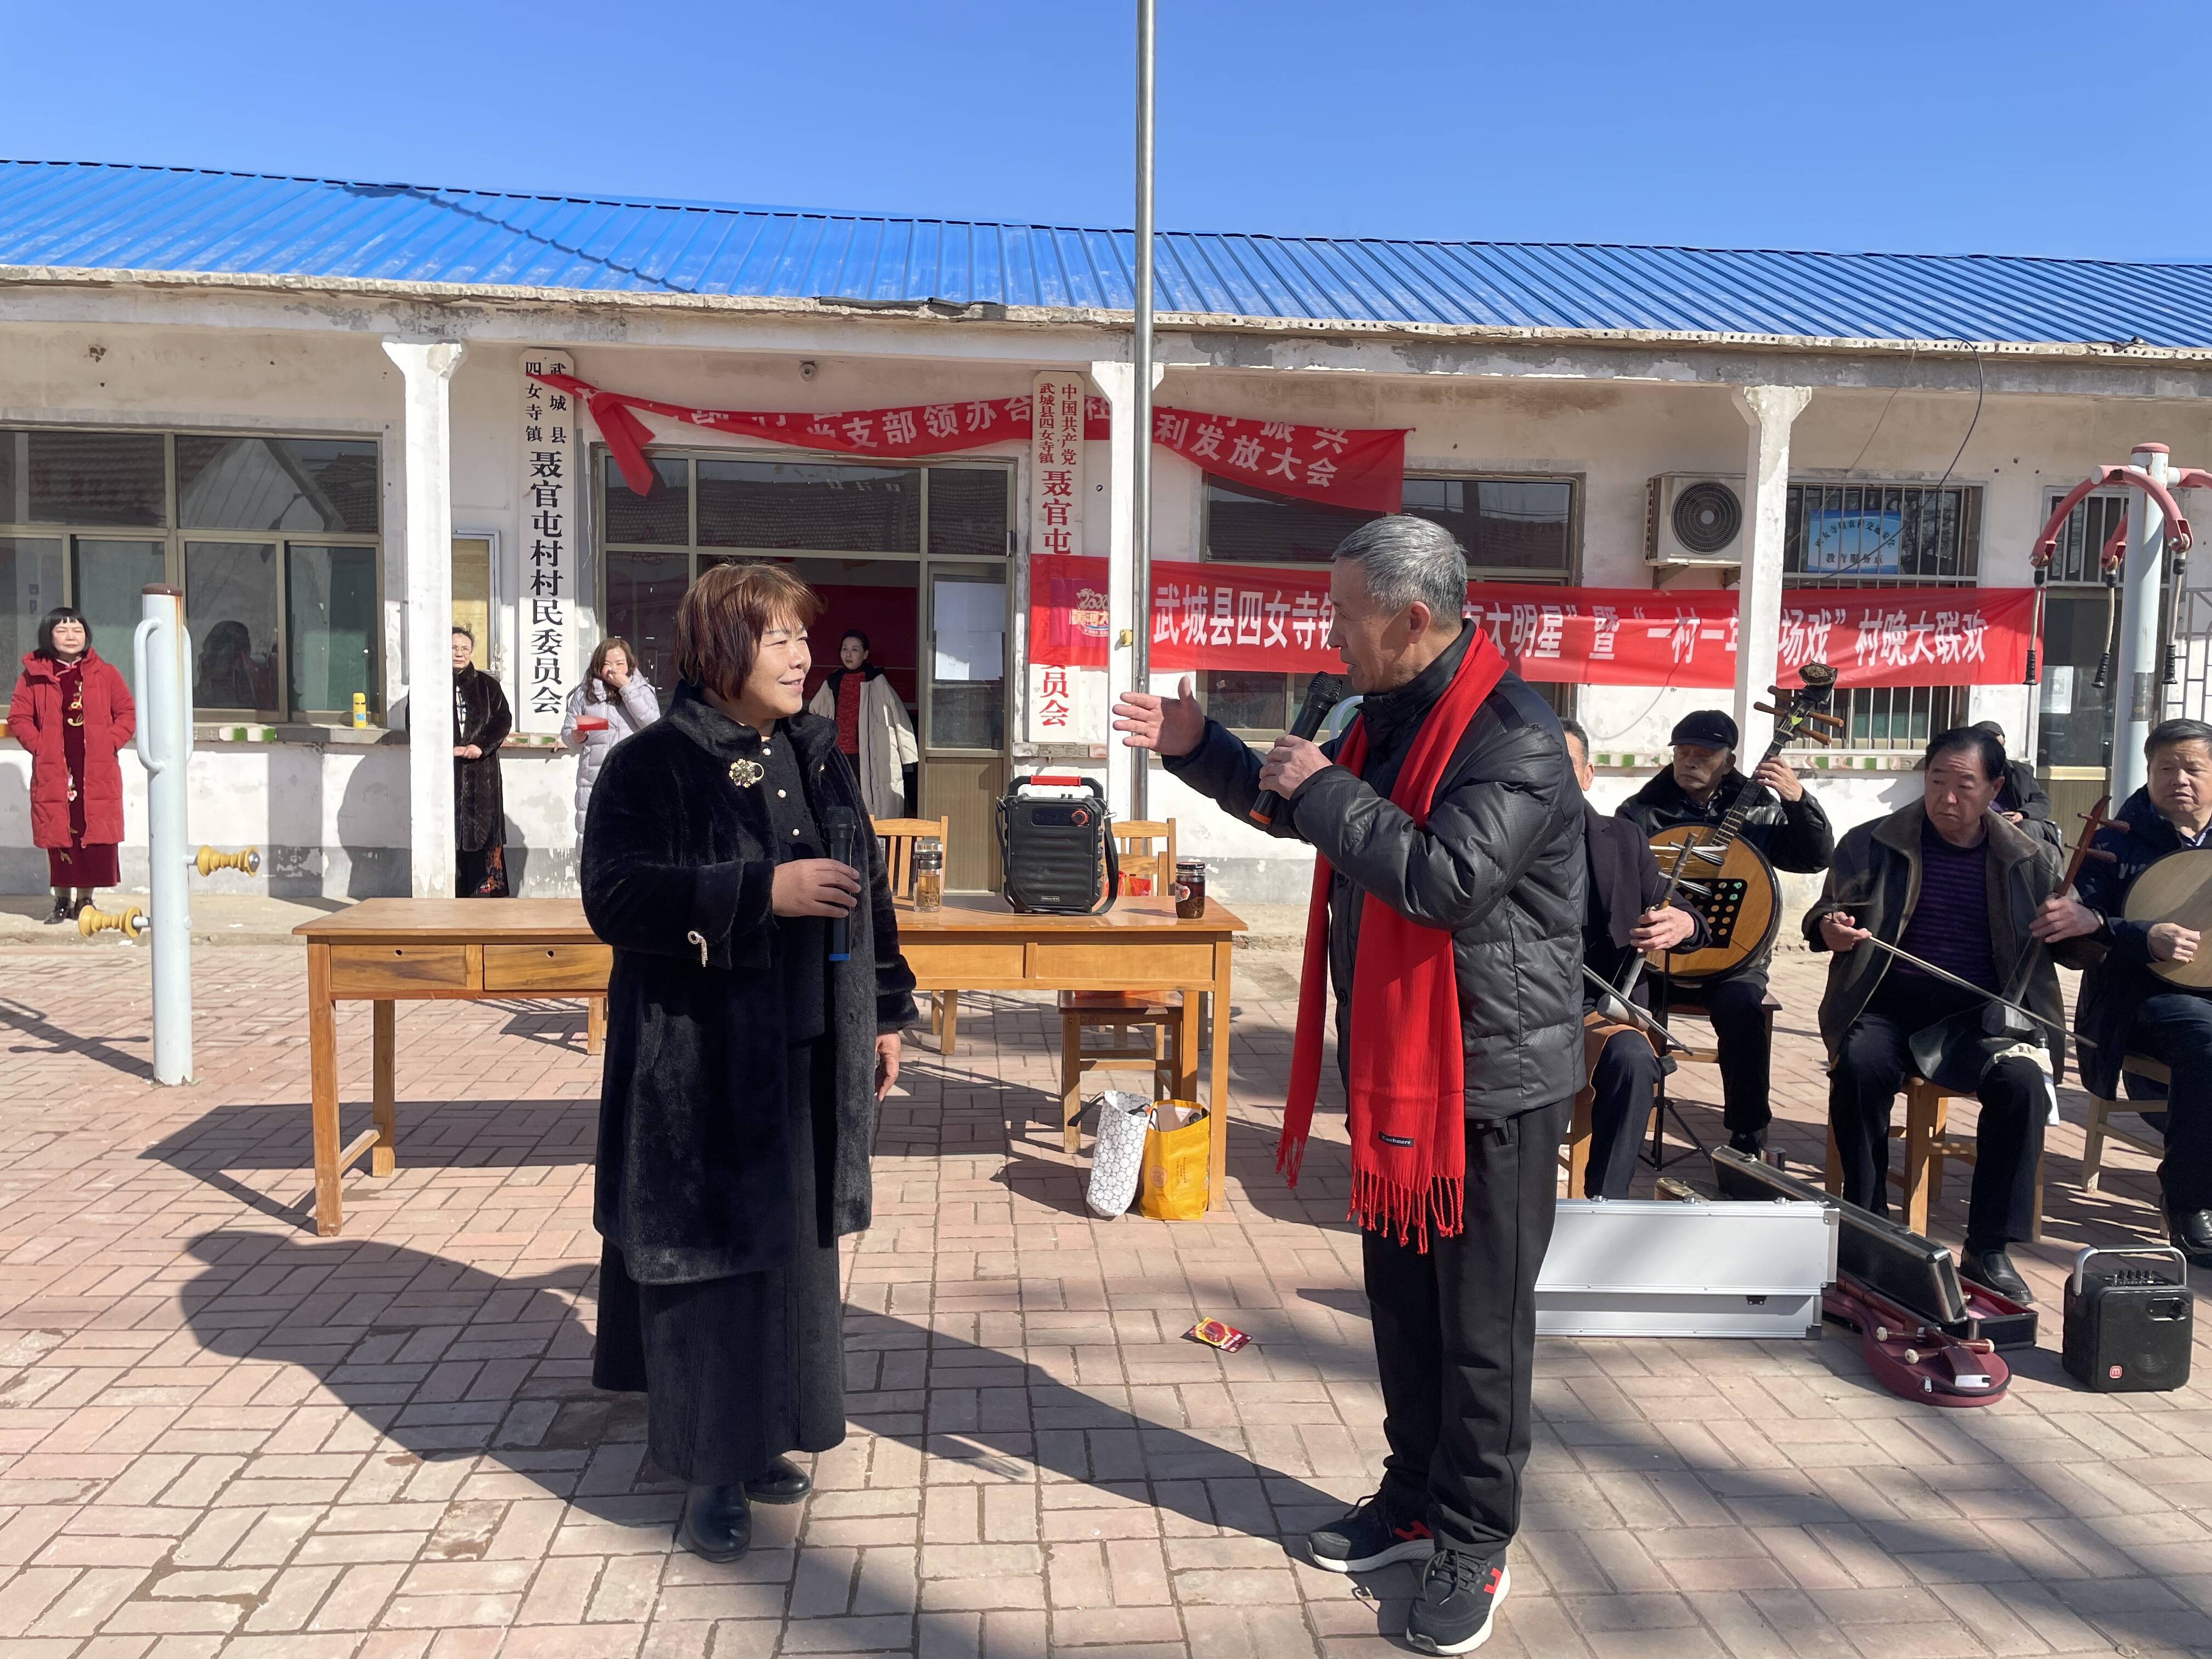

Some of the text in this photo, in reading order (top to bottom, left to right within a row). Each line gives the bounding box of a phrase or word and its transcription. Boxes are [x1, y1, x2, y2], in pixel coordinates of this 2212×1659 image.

[526, 362, 543, 442] 四女寺镇
[550, 363, 567, 444] 武城县
[1039, 383, 1056, 464] 武城县四女寺镇
[1062, 383, 1078, 465] 中国共产党
[1154, 414, 1339, 487] 利发放大会
[529, 451, 564, 713] 聂官屯村村民委员会
[1589, 606, 1619, 660] 暨
[1854, 608, 1989, 667] 村晚大联欢
